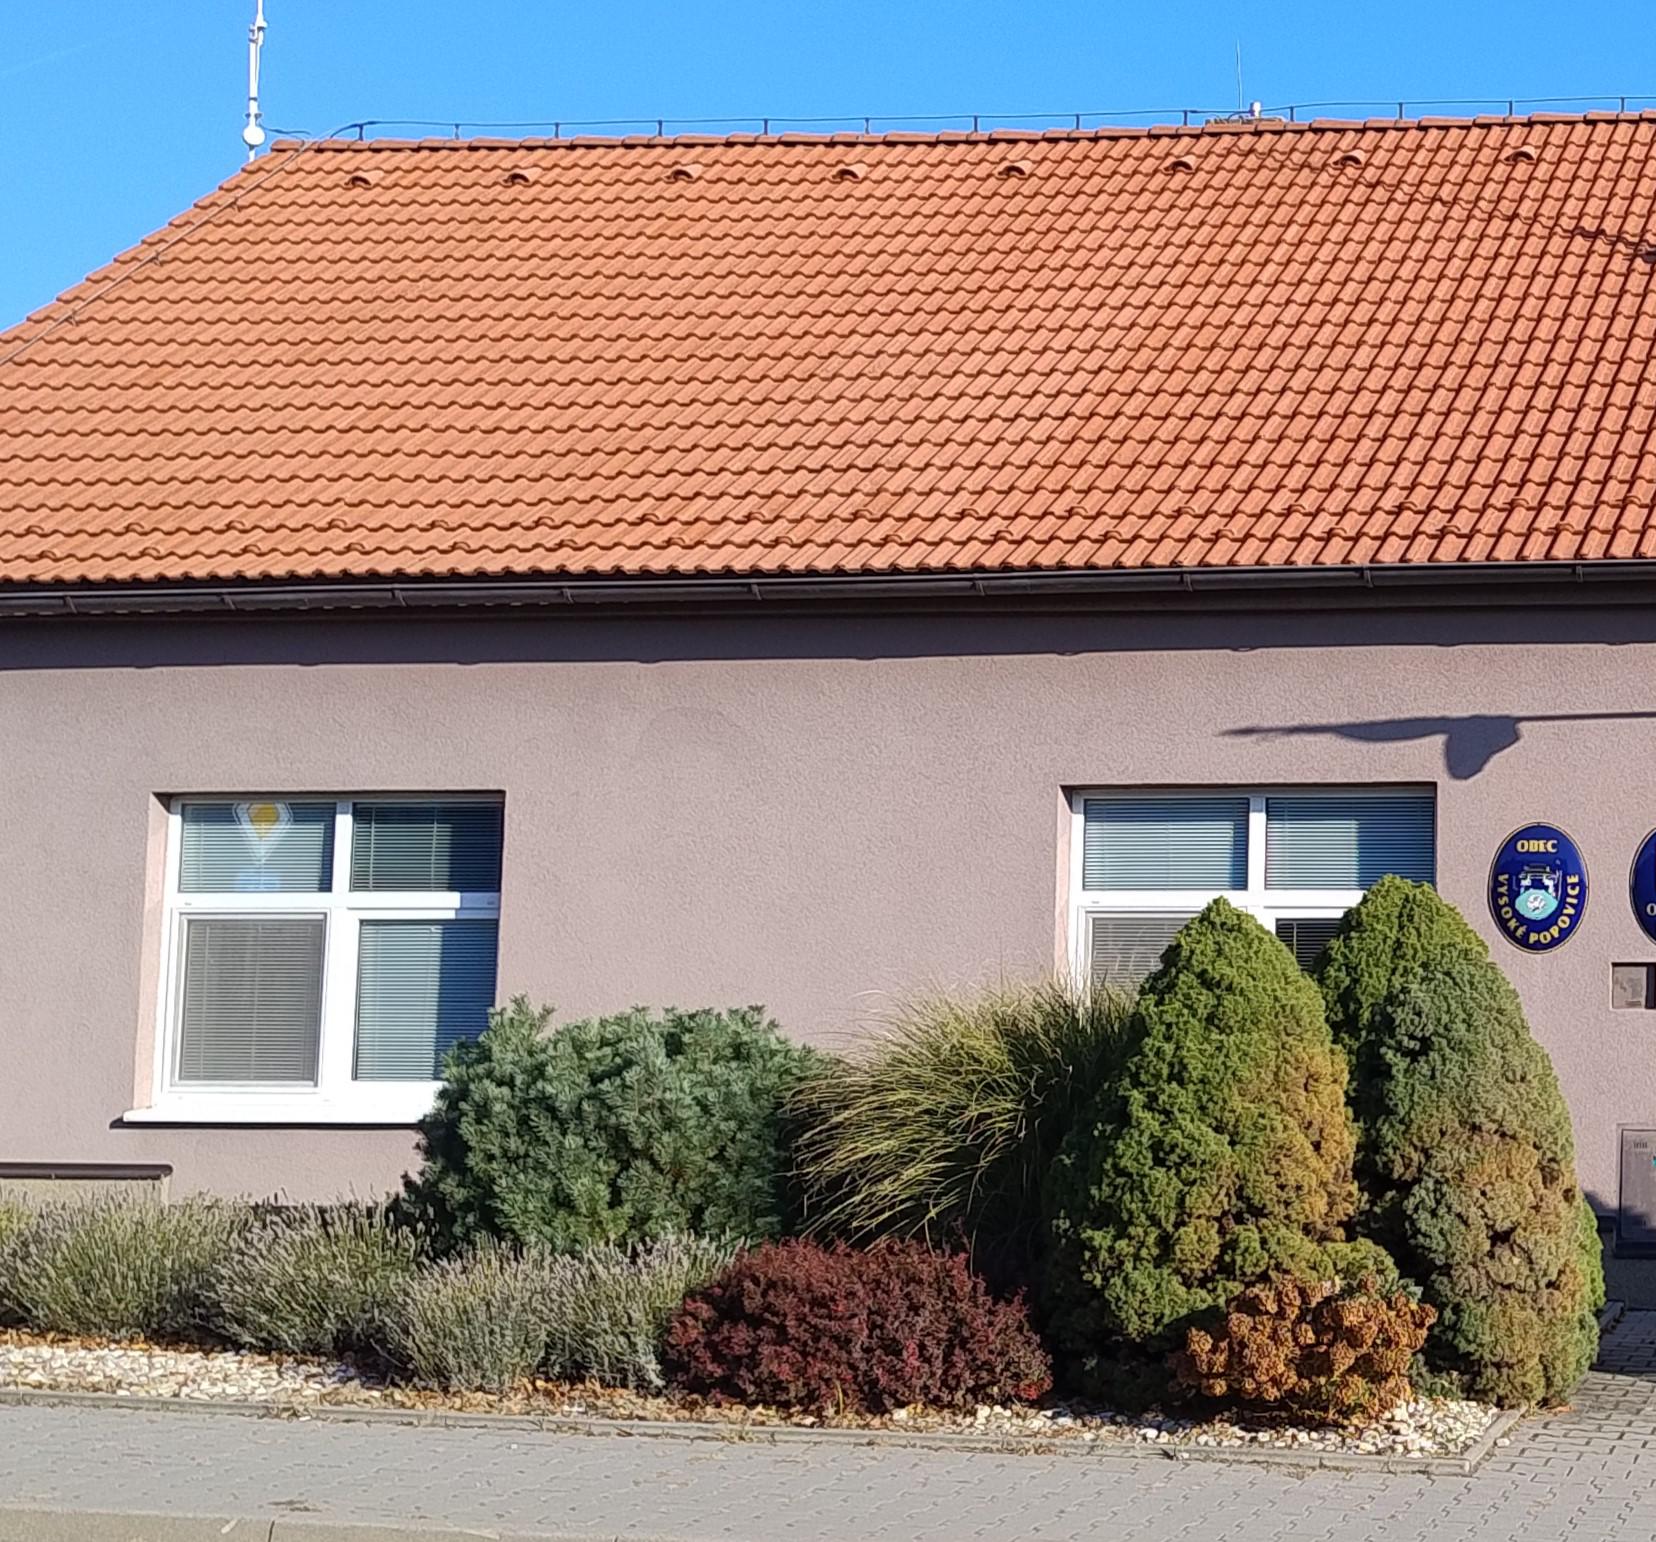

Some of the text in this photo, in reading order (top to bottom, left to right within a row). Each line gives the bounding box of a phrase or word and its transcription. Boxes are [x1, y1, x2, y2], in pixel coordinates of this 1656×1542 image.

[1516, 840, 1558, 853] OBEC
[1497, 873, 1580, 945] VYSOKÉ POPOVICE
